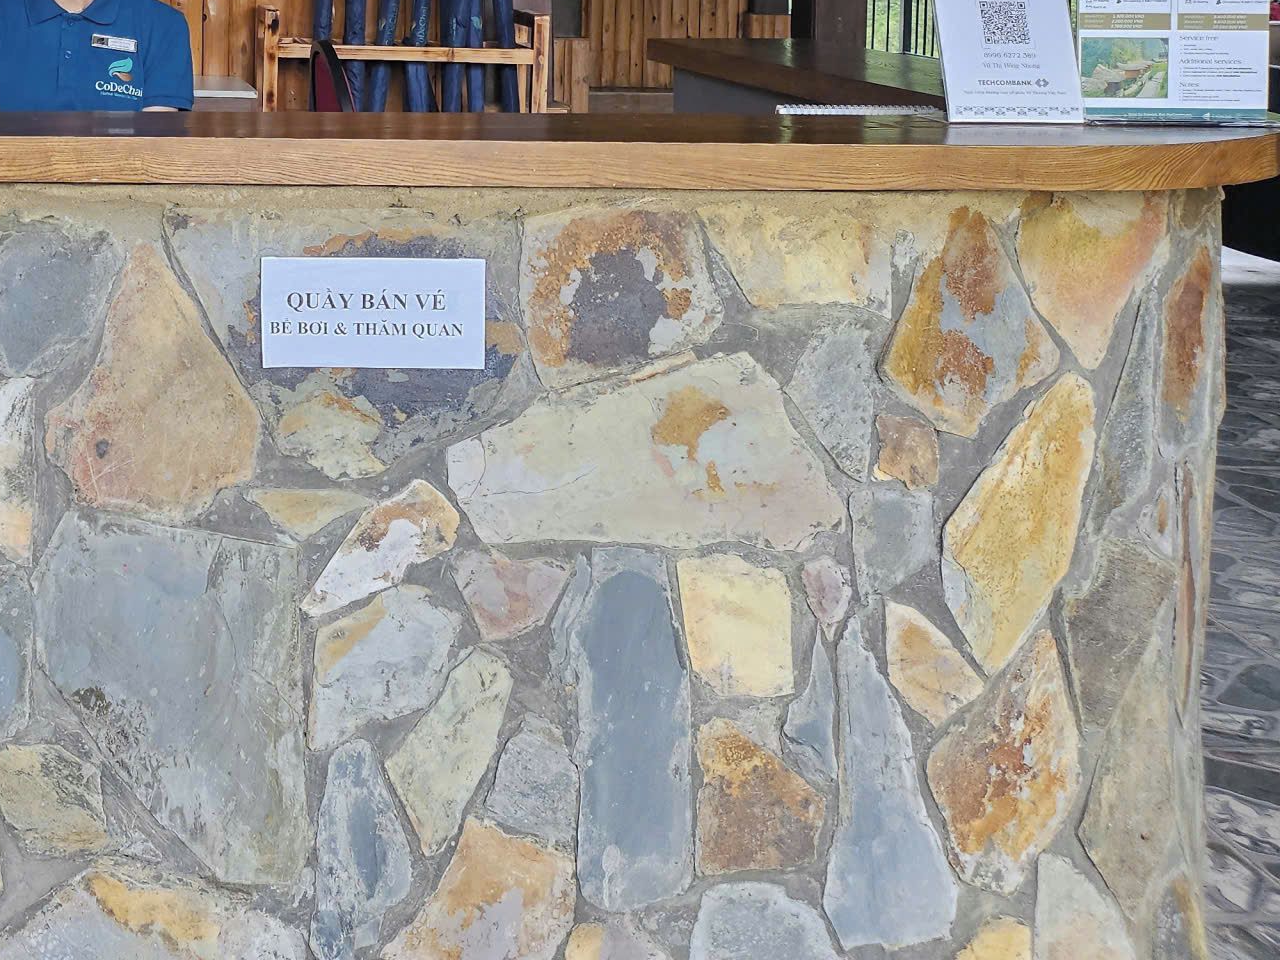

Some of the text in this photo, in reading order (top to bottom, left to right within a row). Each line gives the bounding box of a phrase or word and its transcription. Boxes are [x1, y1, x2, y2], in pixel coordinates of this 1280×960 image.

[95, 80, 143, 97] CoDeChai
[287, 288, 446, 313] QUẦY BÁN VÉ
[298, 321, 328, 335] BƠI
[334, 322, 347, 335] &
[353, 320, 406, 336] THĂM
[412, 323, 463, 340] QUAN
